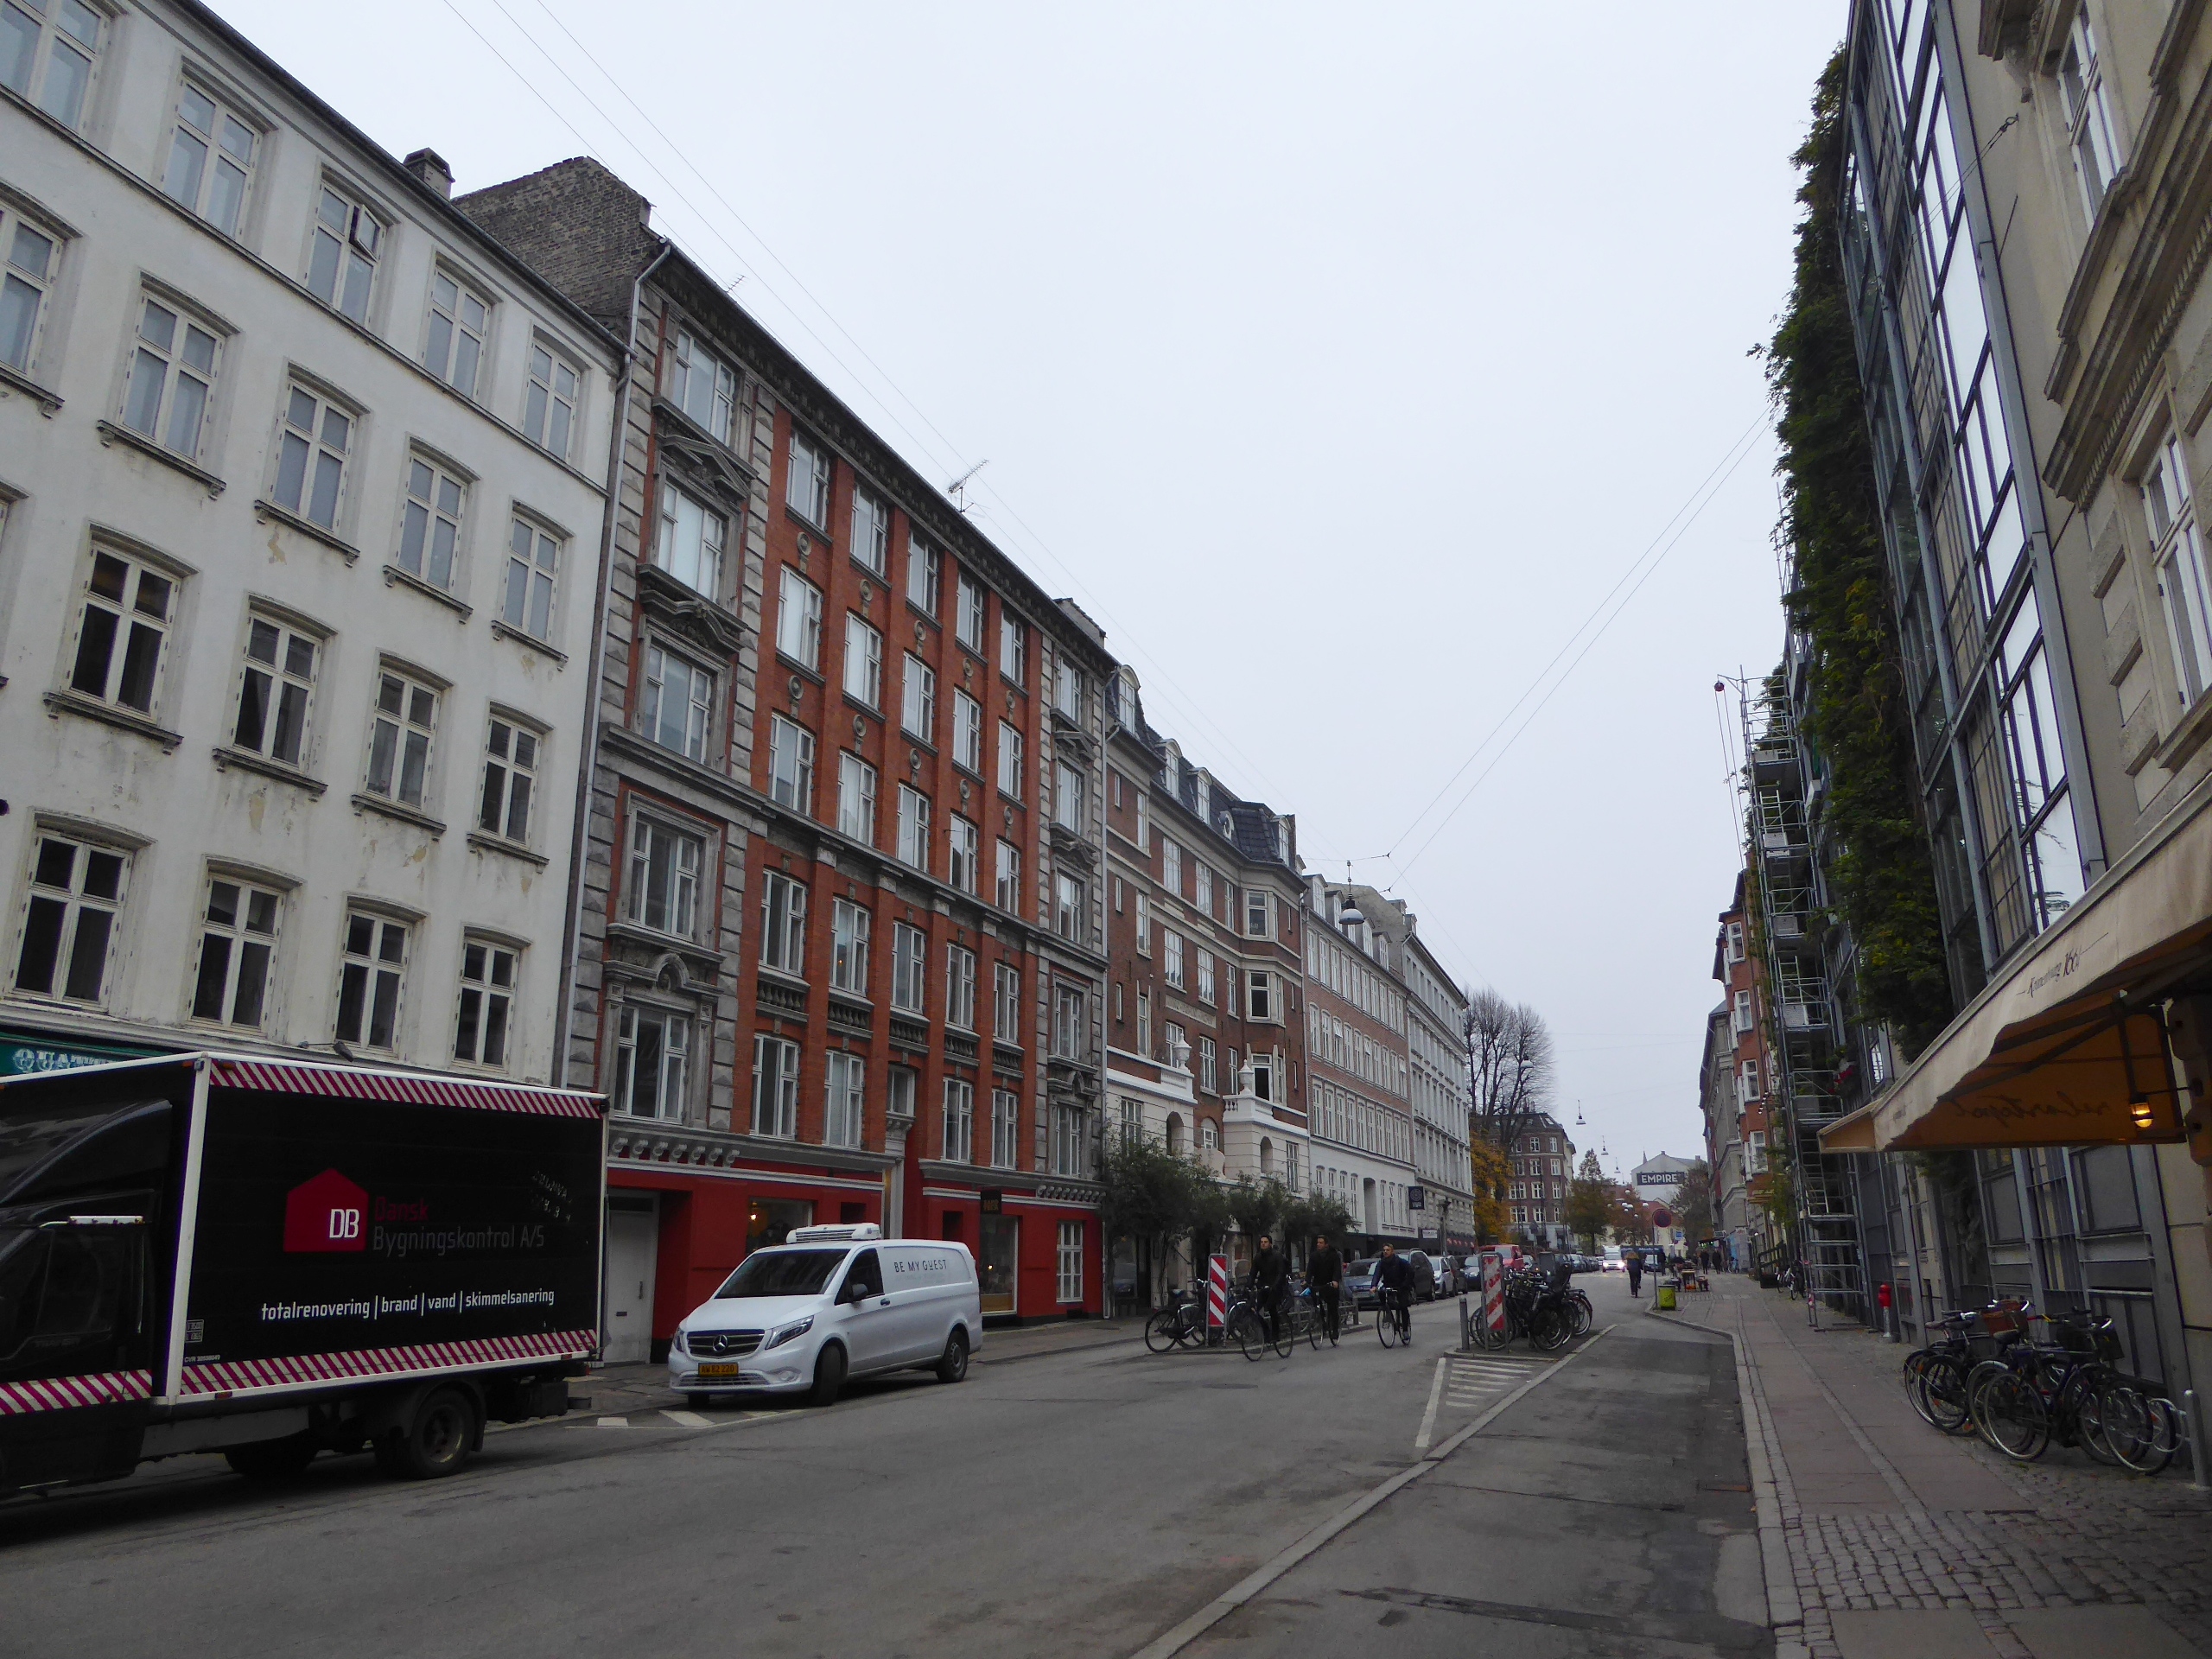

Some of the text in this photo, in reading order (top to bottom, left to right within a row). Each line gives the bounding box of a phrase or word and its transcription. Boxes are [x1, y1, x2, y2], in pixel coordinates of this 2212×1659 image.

[1641, 1173, 1678, 1184] EMPIRE
[328, 1208, 360, 1239] DB
[375, 1197, 429, 1222] Dansk
[372, 1224, 544, 1257] Bygningskontrol A/S
[893, 1259, 947, 1273] BE MY GUEST
[261, 1287, 556, 1321] totalrenovering brand vand skimmelsanering
